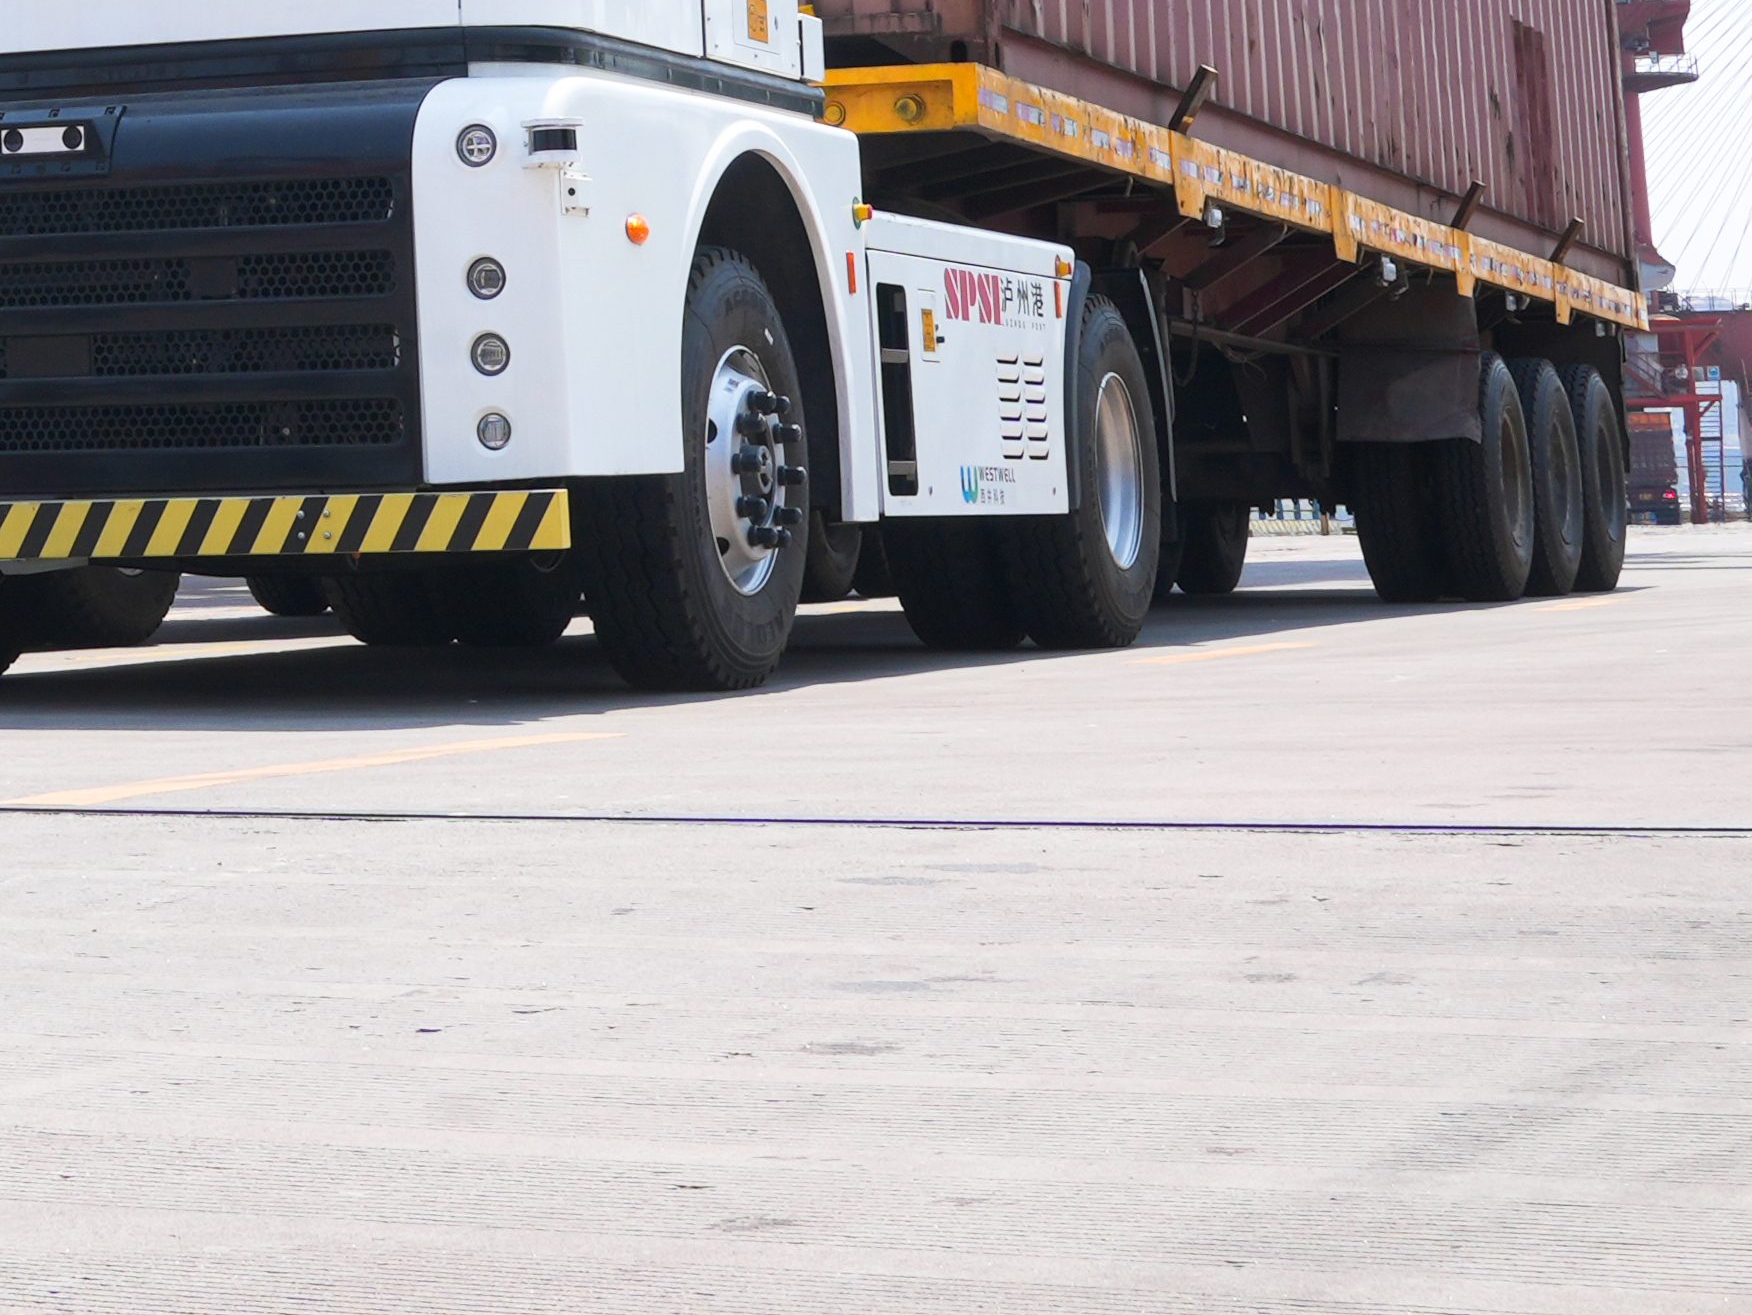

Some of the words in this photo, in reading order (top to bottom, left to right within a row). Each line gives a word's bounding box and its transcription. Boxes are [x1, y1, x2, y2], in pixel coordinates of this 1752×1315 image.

[944, 267, 1003, 326] SPSI
[1002, 277, 1044, 318] 泸州港
